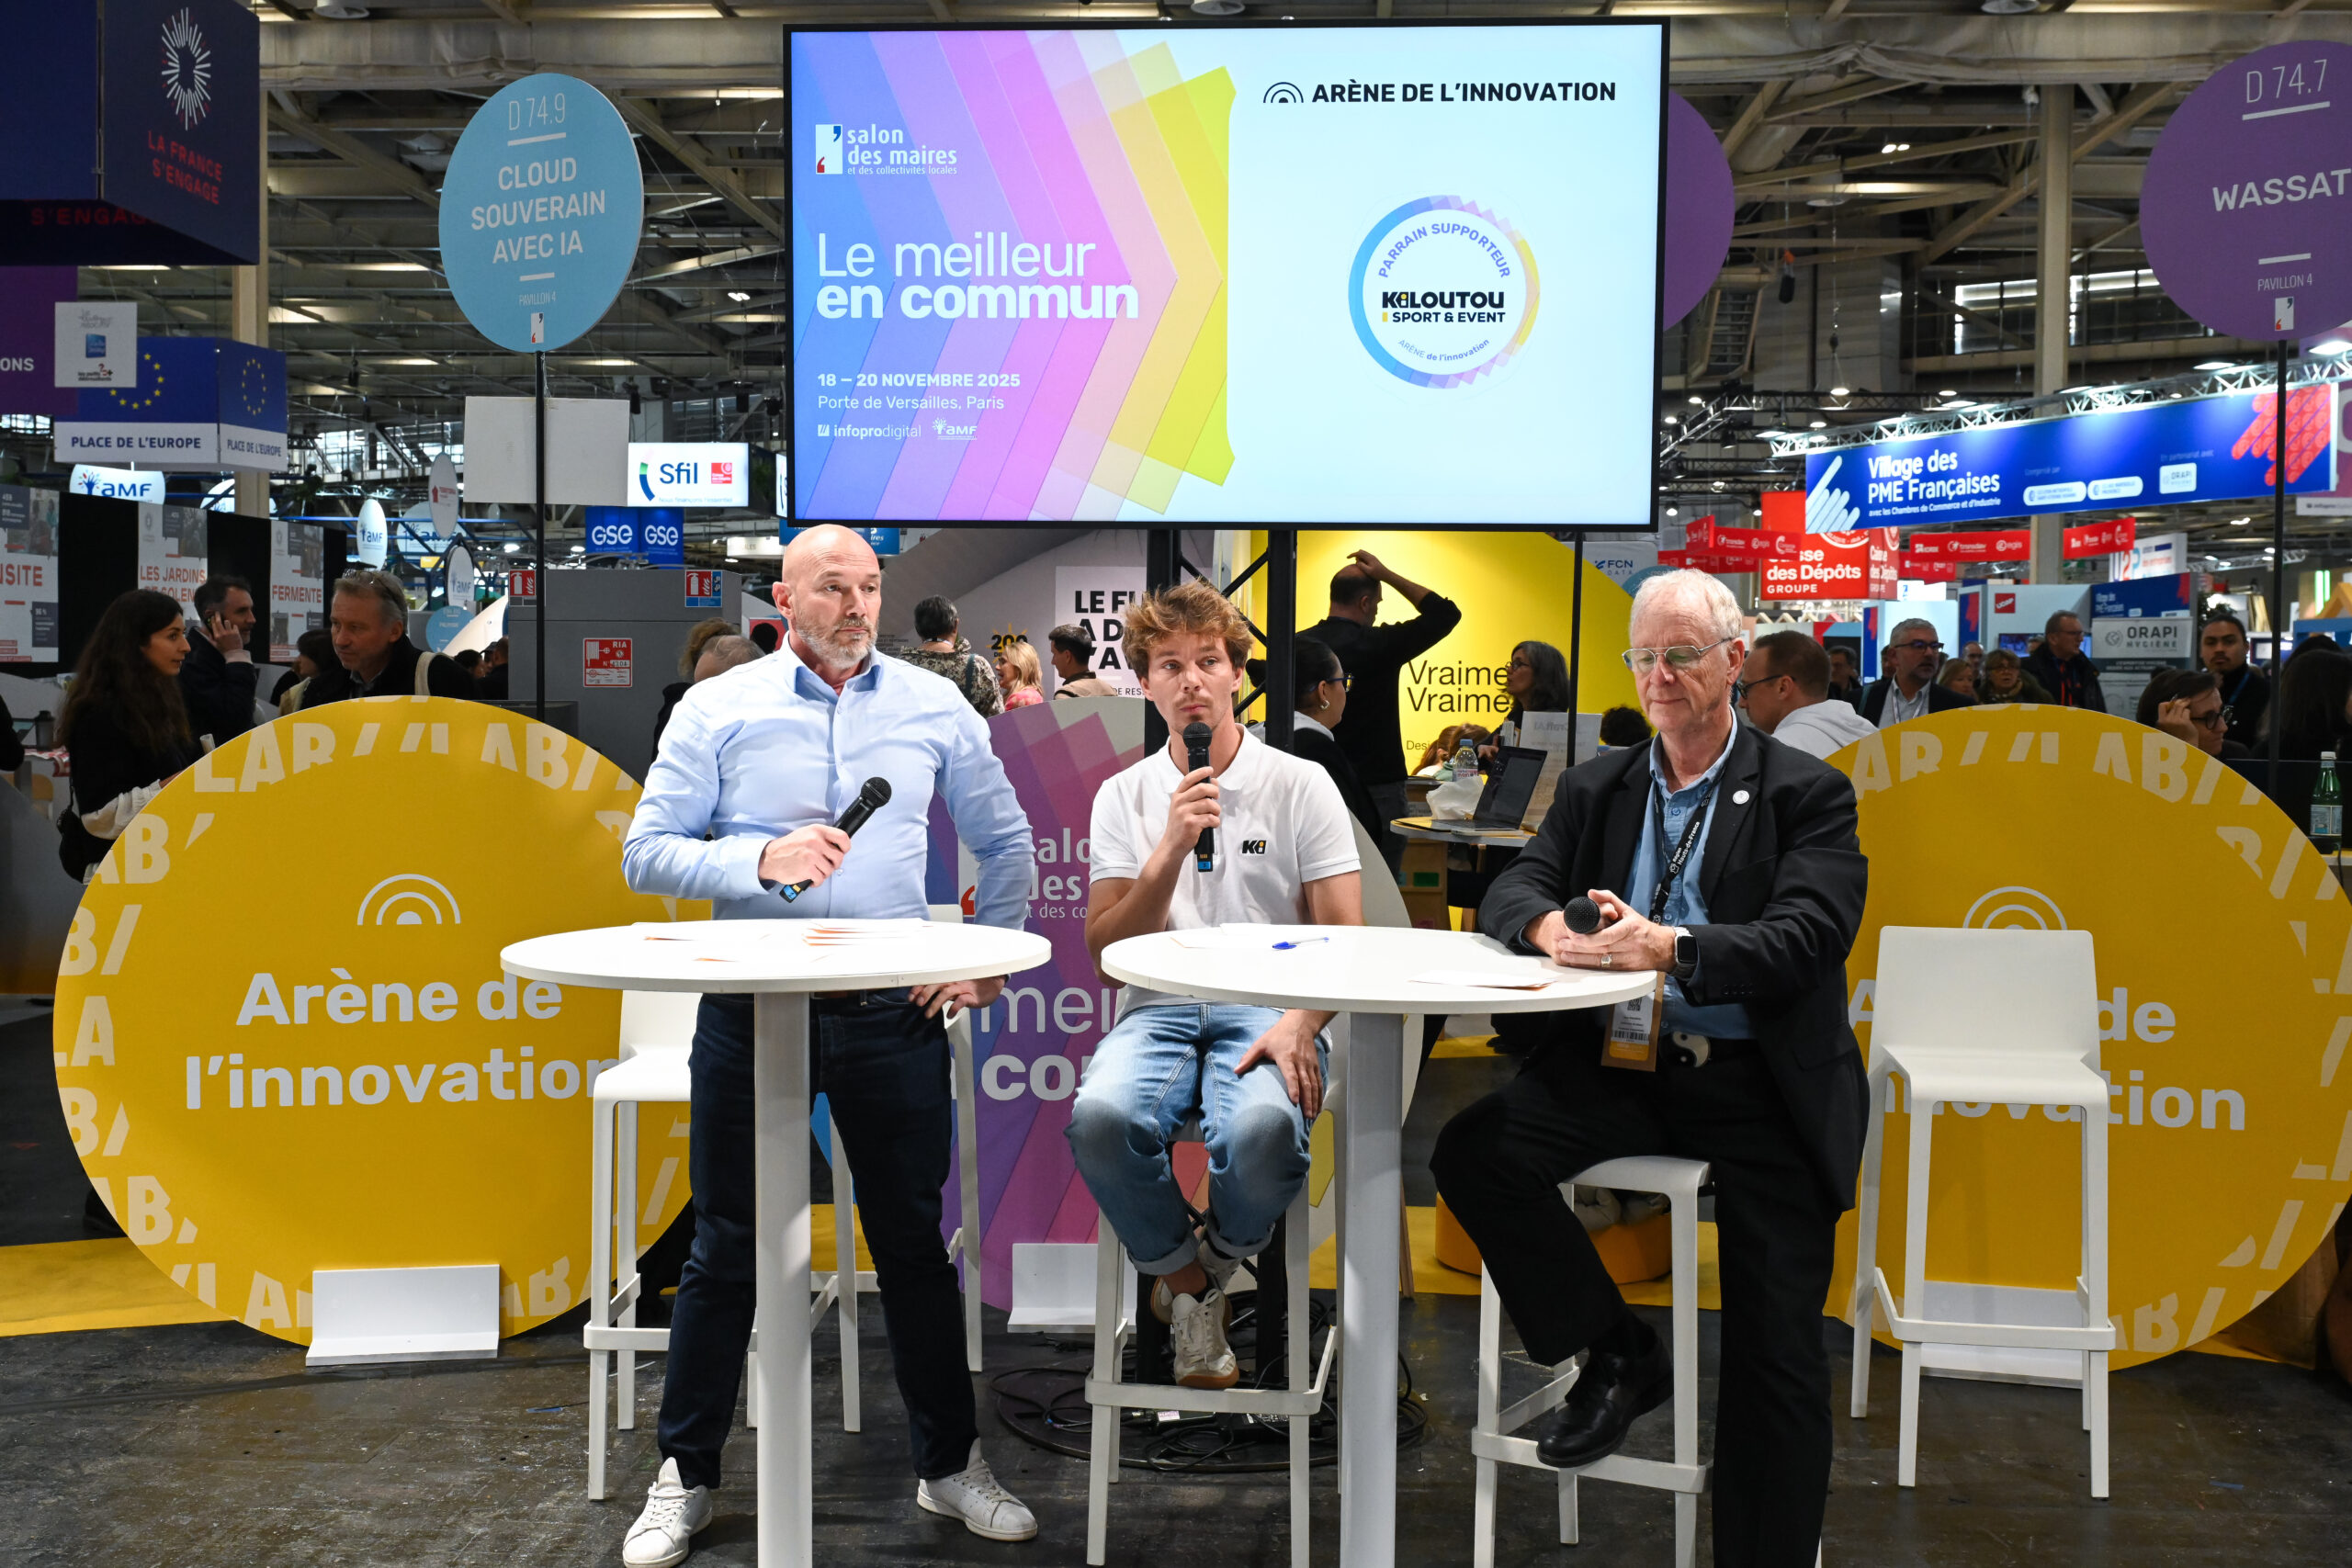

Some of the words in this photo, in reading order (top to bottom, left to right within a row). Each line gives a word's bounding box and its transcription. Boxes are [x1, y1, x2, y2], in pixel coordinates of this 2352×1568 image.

[1312, 79, 1396, 102] ARÈNE
[1402, 84, 1434, 102] DE
[2246, 71, 2263, 103] D
[2272, 59, 2328, 99] 74.7
[509, 100, 520, 131] D
[526, 93, 566, 127] 74.9
[847, 124, 904, 144] salon
[148, 130, 166, 152] LA
[170, 141, 223, 181] FRANCE
[848, 146, 882, 165] des
[889, 146, 957, 165] maires
[498, 158, 577, 190] CLOUD
[847, 166, 856, 175] et
[859, 165, 874, 175] des
[876, 165, 927, 175] collectivités
[929, 165, 957, 175] locales
[471, 190, 605, 230] SOUVERAIN
[492, 234, 554, 264] AVEC
[560, 230, 583, 256] IA
[819, 232, 875, 277] Le
[895, 231, 1096, 277] meilleur
[1378, 226, 1429, 279] PARRAIN
[1431, 223, 1511, 279] SUPPORTEUR
[2257, 275, 2305, 291] PAVILLON
[2307, 273, 2312, 285] 4
[519, 292, 550, 306] PAVILLON
[552, 291, 556, 302] 4
[817, 284, 883, 318] en
[900, 284, 1139, 319] commun
[1392, 312, 1441, 323] SPORT
[1444, 312, 1454, 323] &
[1458, 312, 1506, 323] EVENT
[1426, 352, 1438, 361] de
[817, 374, 837, 387] 18
[856, 374, 877, 387] 20
[882, 374, 973, 387] NOVEMBRE
[978, 374, 1021, 387] 2025
[818, 395, 859, 409] Porte
[863, 396, 882, 409] de
[886, 395, 962, 411] Versailles,
[967, 396, 1004, 409] Paris
[834, 424, 921, 440] infoprodigital
[71, 437, 112, 448] PLACE
[117, 437, 134, 448] DE
[227, 439, 245, 452] PLACE
[247, 442, 255, 453] DE
[659, 462, 698, 485] Sfil
[1868, 456, 1923, 481] Village
[1927, 449, 1958, 473] des
[1869, 480, 1904, 504] PME
[1908, 472, 2001, 500] Françaises
[592, 525, 633, 545] GSE
[645, 525, 678, 546] GSE
[1608, 560, 1633, 568] FCN
[1767, 566, 1798, 581] des
[1800, 564, 1861, 582] Dépôts
[141, 566, 159, 581] LES
[163, 568, 206, 584] JARDINS
[272, 585, 322, 603] FERMENTE
[1767, 584, 1817, 593] GROUPE
[1075, 591, 1104, 613] LE
[2127, 626, 2177, 638] ORAPI
[1678, 821, 1701, 865] Hauts-de-France
[1039, 903, 1066, 919] des
[236, 968, 458, 1026] Arène
[478, 974, 562, 1020] de
